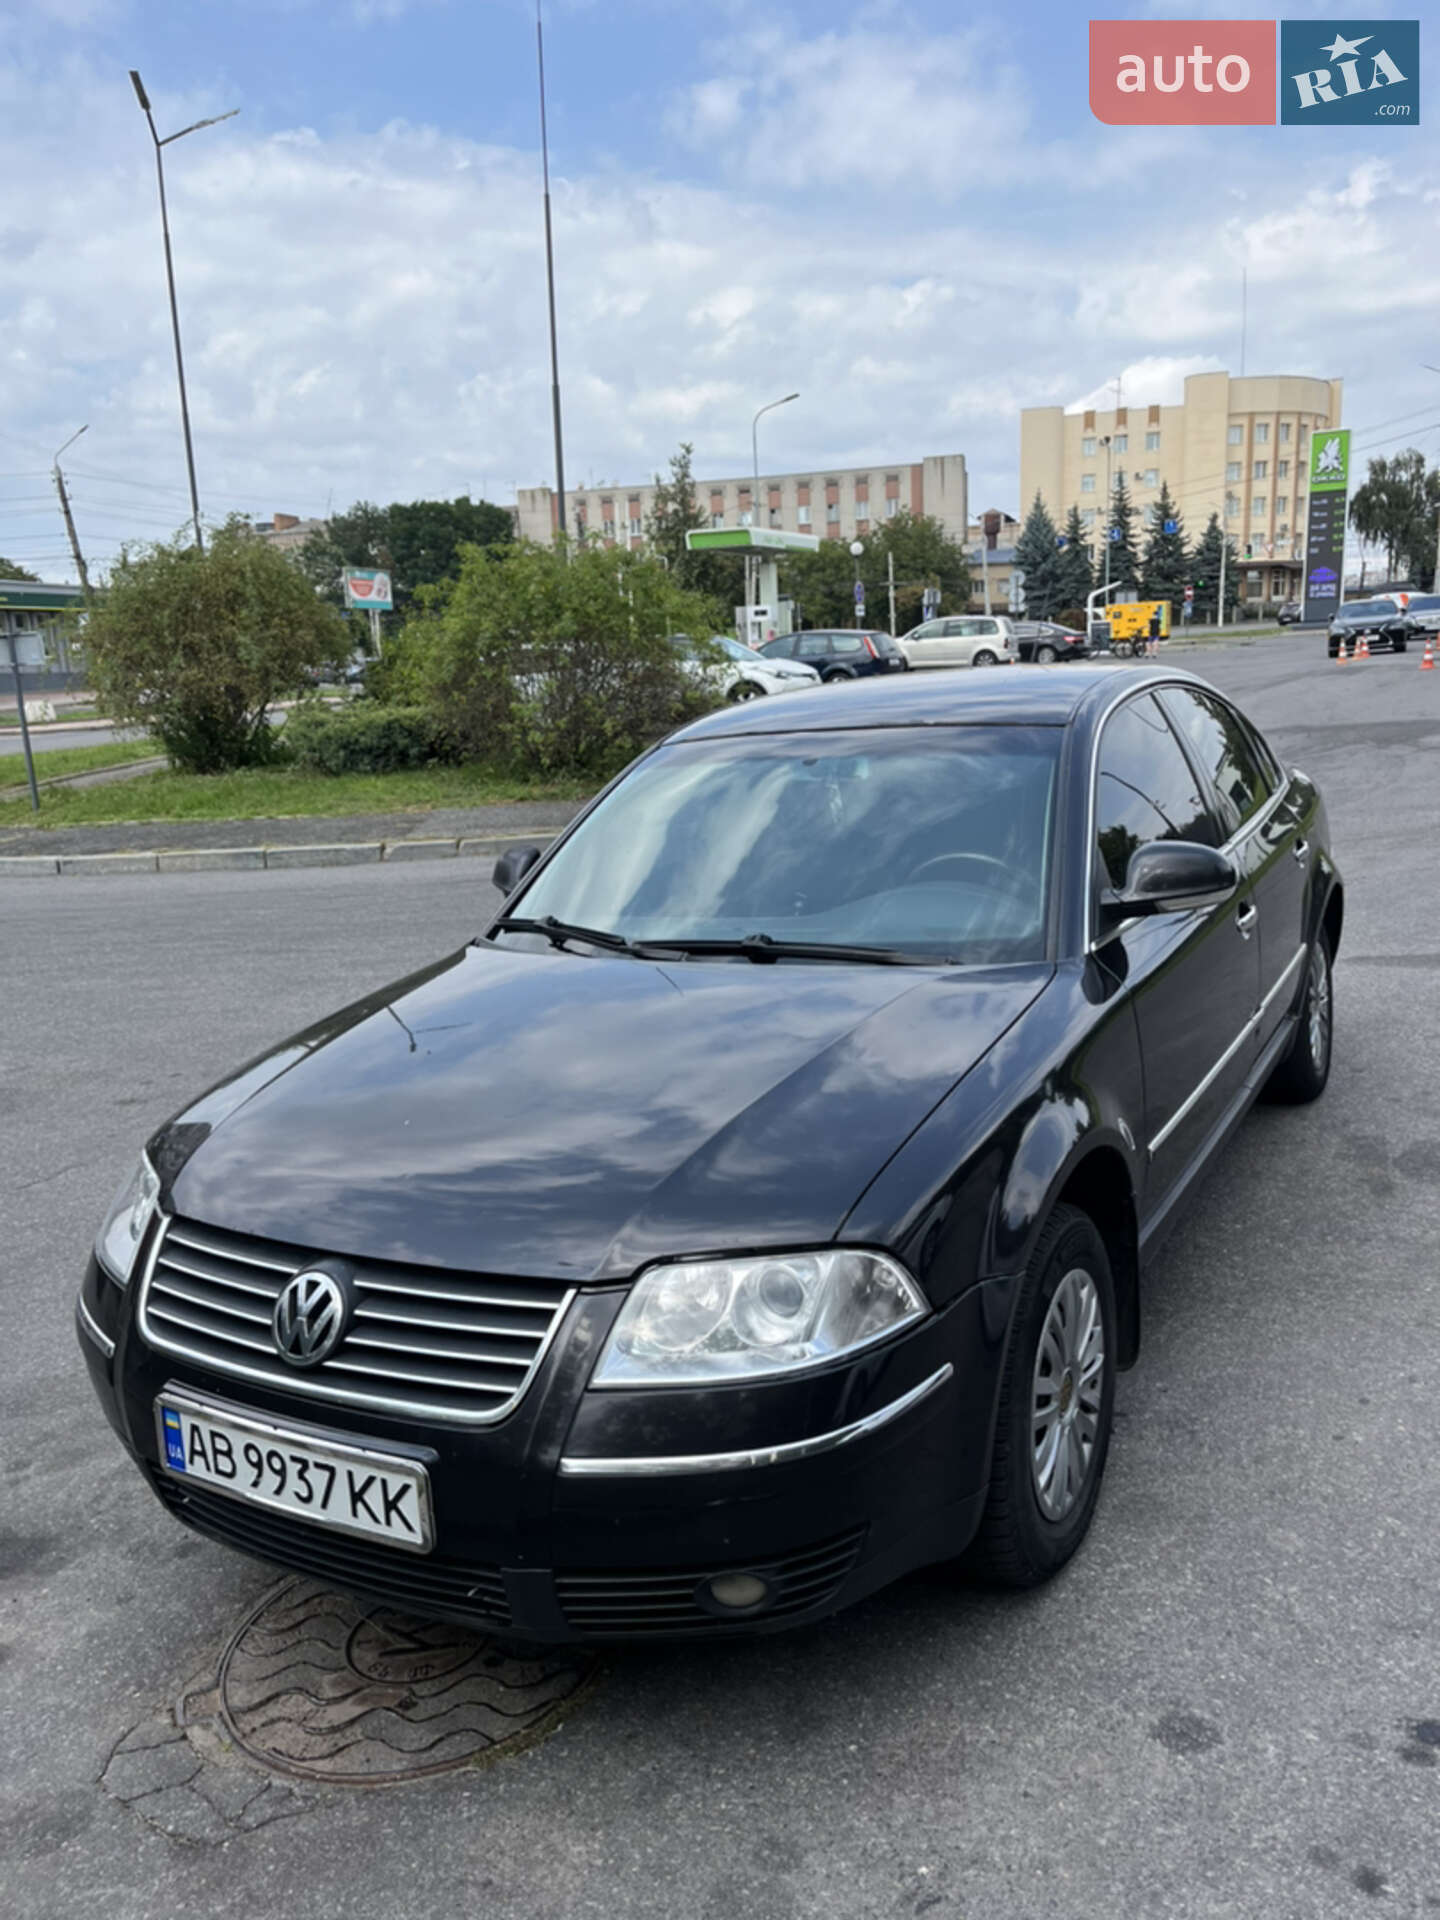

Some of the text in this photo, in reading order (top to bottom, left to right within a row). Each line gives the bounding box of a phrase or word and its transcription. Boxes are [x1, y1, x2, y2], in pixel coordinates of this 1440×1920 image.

[168, 1444, 184, 1460] UA
[188, 1423, 416, 1534] AB 9937 KK
